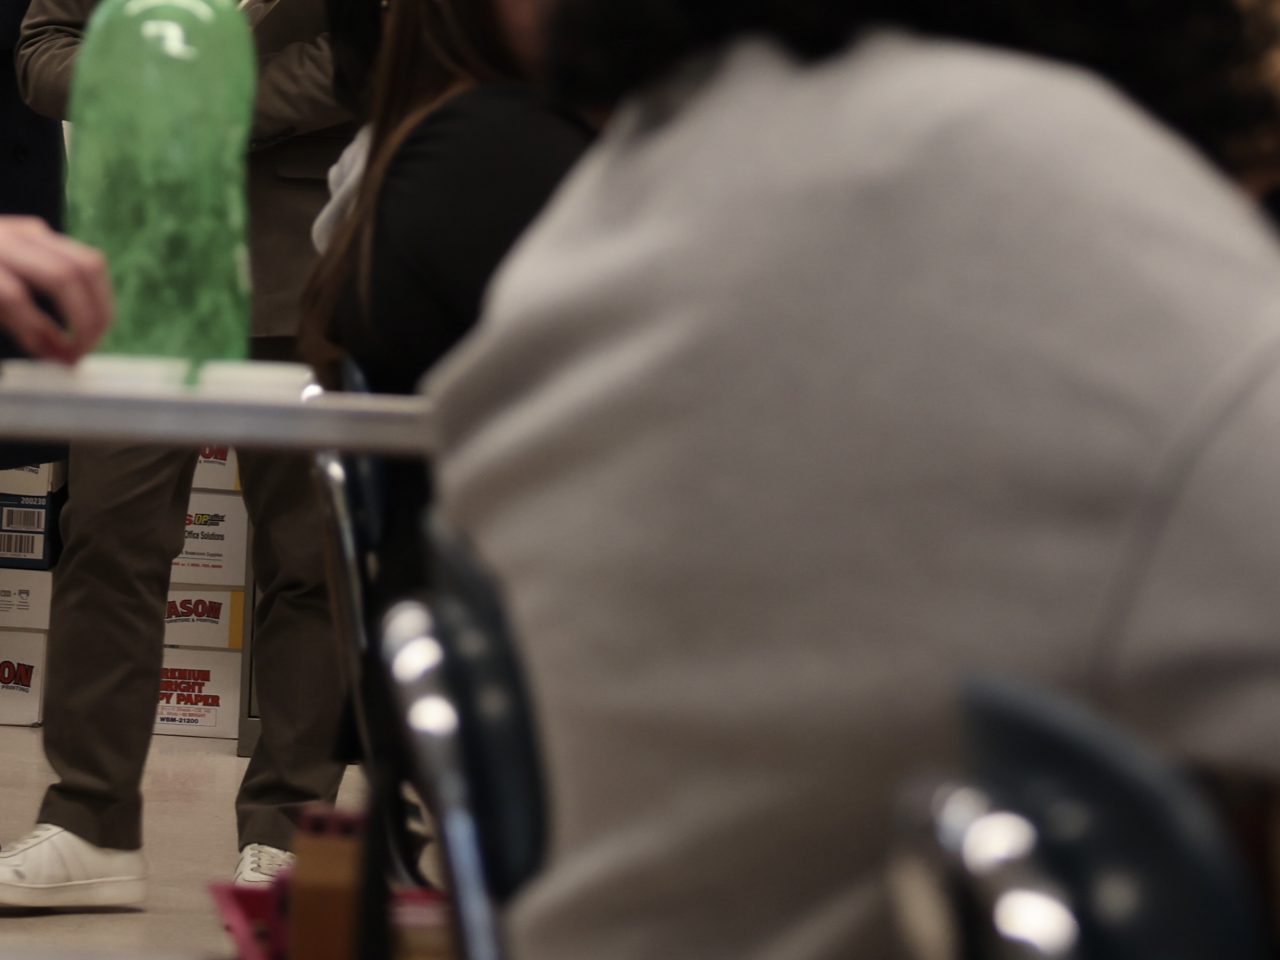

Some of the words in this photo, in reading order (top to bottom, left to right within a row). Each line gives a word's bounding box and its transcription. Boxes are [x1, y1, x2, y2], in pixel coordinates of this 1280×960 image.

[198, 444, 228, 461] ON
[20, 497, 47, 506] 200230
[200, 531, 225, 541] Solutions
[166, 599, 223, 619] ASON
[160, 667, 211, 681] REMIUM
[160, 692, 174, 705] PY
[176, 693, 220, 707] PAPER
